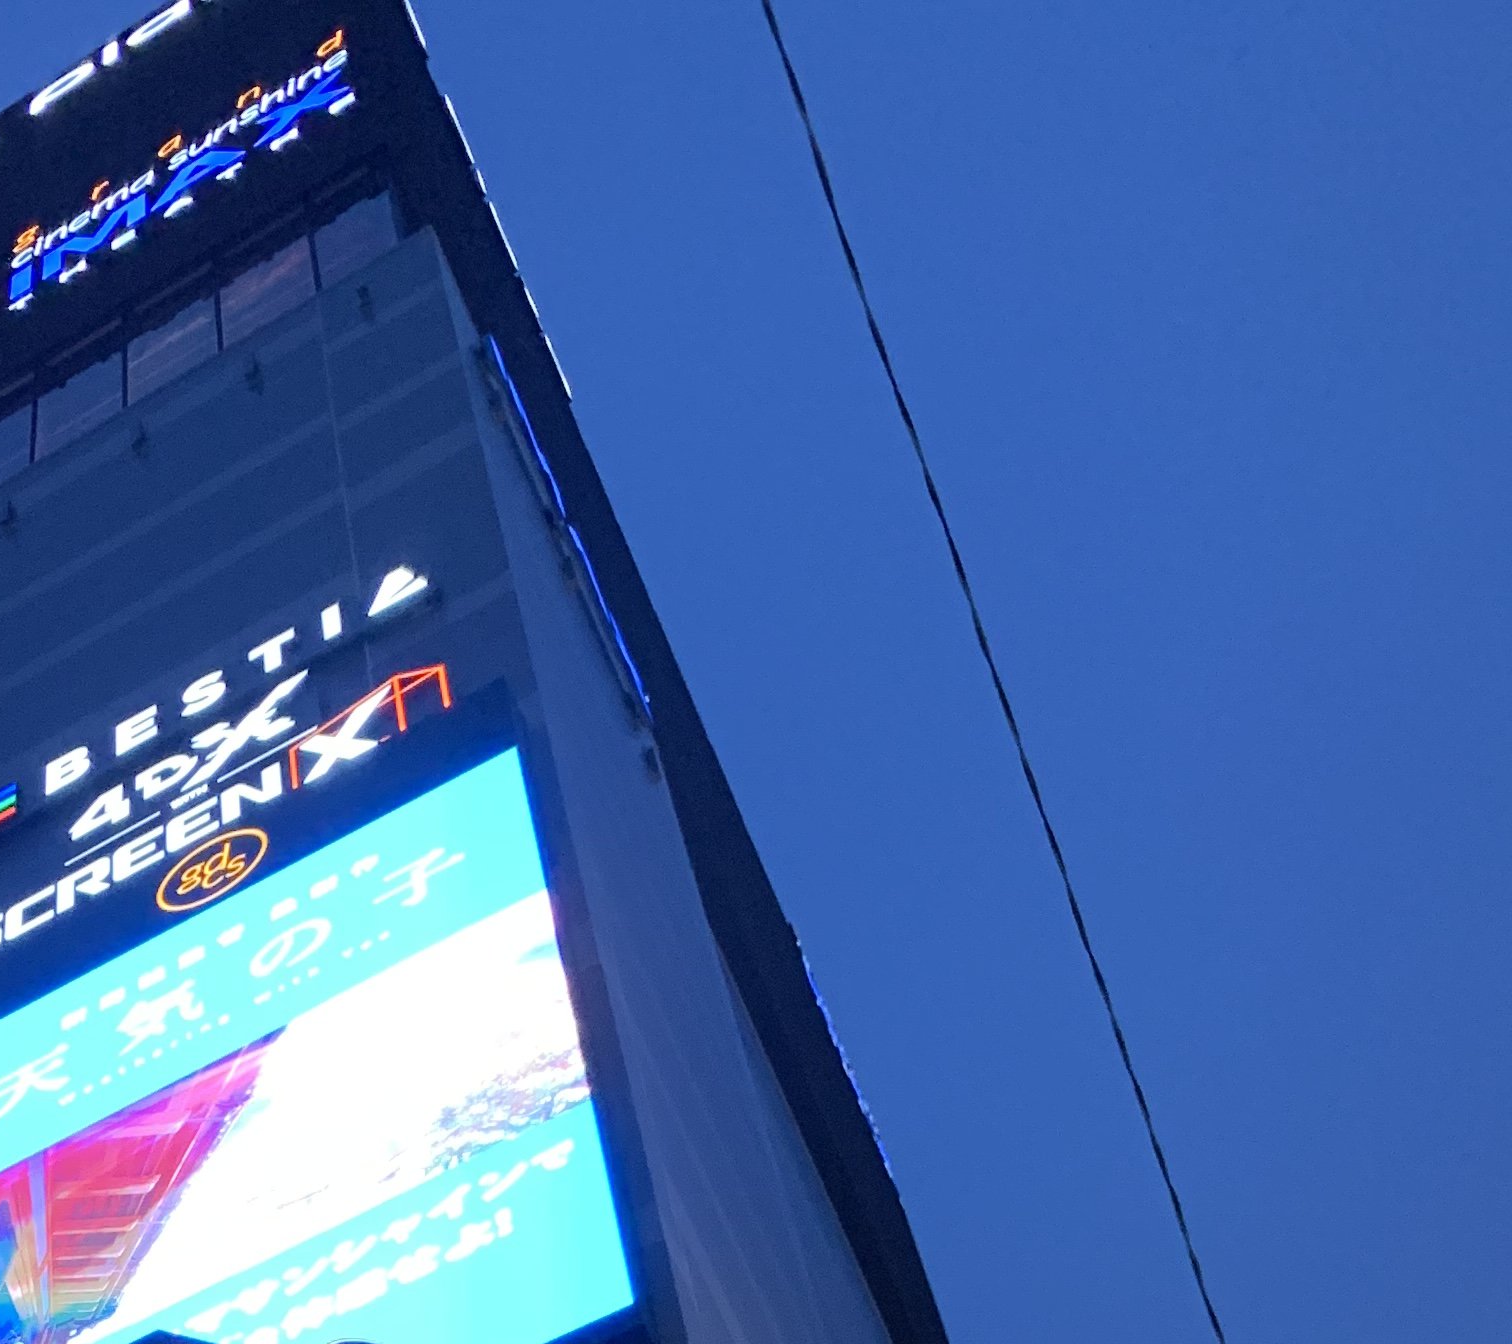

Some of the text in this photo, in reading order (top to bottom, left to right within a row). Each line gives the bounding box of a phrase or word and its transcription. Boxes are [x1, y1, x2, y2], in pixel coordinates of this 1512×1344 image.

[8, 68, 354, 302] IMAX
[10, 48, 349, 269] cinema sunshine
[68, 669, 310, 842] 4DX
